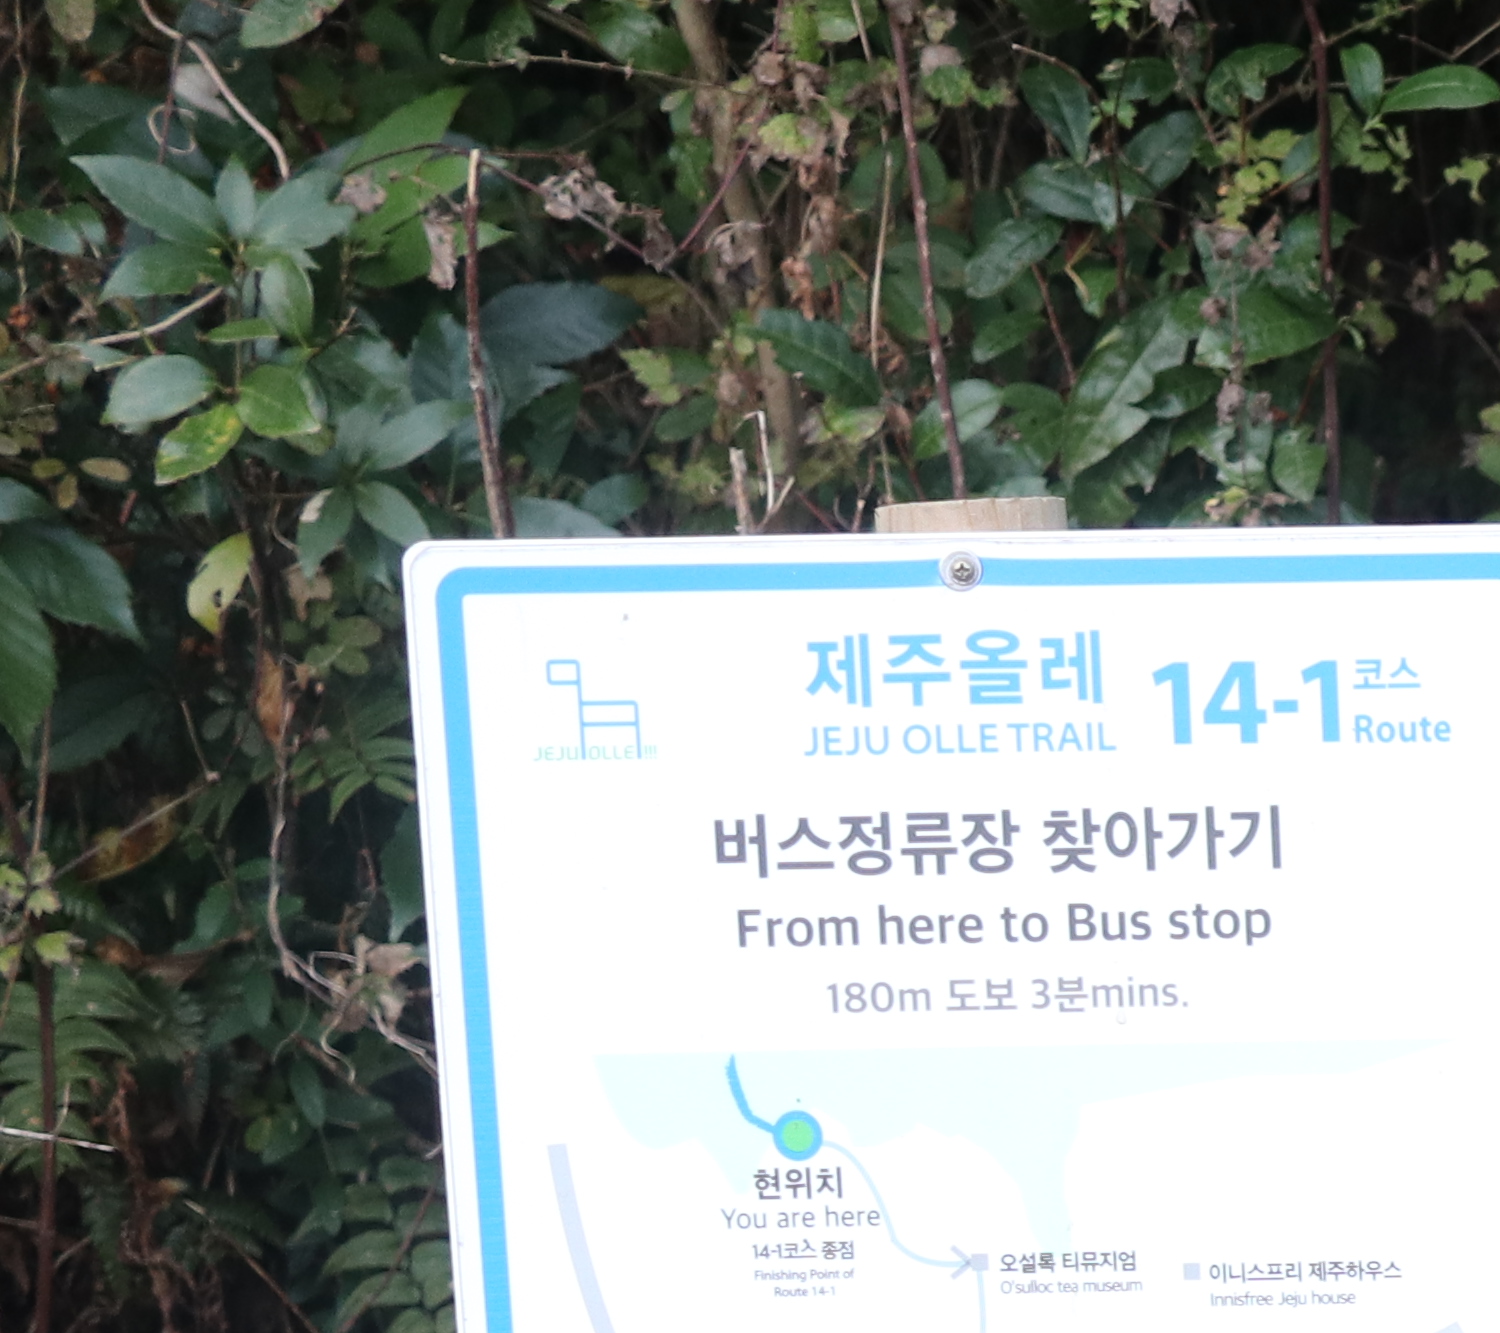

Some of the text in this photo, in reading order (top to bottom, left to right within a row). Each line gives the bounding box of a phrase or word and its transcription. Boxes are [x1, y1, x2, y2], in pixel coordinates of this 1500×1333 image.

[806, 630, 1103, 707] 제주올레
[1353, 657, 1421, 689] 코스
[1152, 660, 1340, 744] 14-1
[804, 722, 1117, 756] JEJU OLLE TRAIL
[1353, 714, 1451, 743] Route
[714, 805, 1281, 878] 버스정류장 찾아가기
[737, 903, 1271, 947] From here to Bus stop
[827, 982, 931, 1013] 180m
[947, 978, 1017, 1011] 도보
[753, 1167, 842, 1200] 현위치
[721, 1209, 767, 1229] You
[825, 1205, 880, 1227] here
[753, 1239, 854, 1260] 14-1코스 종점
[1000, 1251, 1136, 1273] 오설록 티뮤지엄
[1209, 1261, 1402, 1283] 이니스프리 제주하우스
